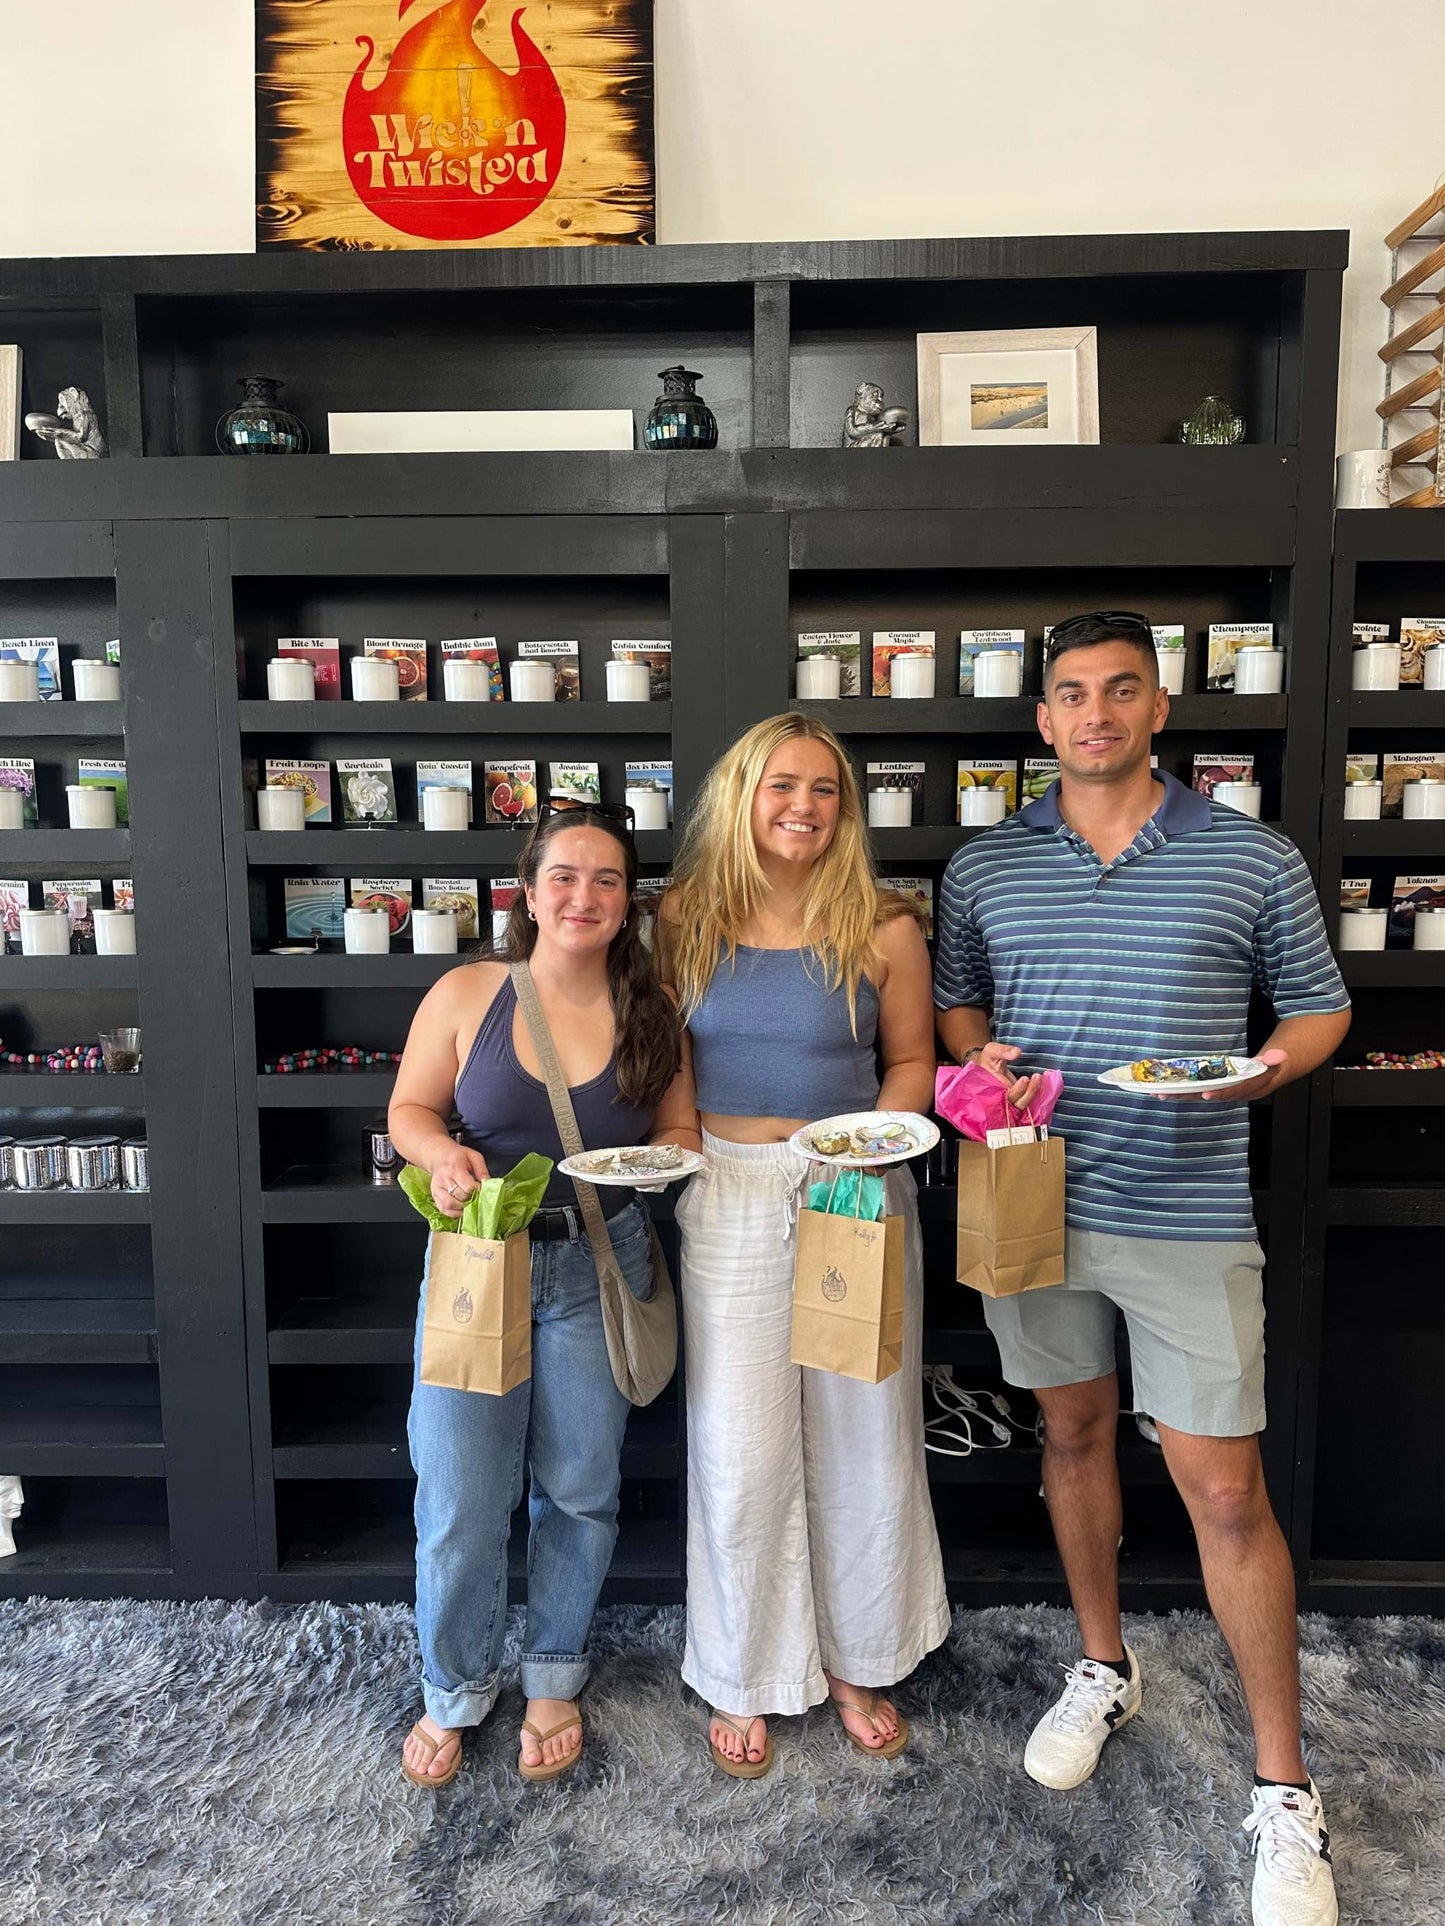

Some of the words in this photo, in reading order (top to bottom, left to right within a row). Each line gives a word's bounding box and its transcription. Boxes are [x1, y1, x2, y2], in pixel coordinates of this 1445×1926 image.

[353, 148, 548, 195] Twisted
[1212, 625, 1270, 634] Champagne
[1, 641, 27, 649] Beach
[29, 639, 55, 647] Linen
[290, 639, 309, 648] Bite
[311, 639, 324, 648] Me
[366, 639, 389, 648] Blood
[391, 640, 424, 650] Orange
[443, 641, 472, 650] Bubble
[473, 640, 494, 648] Gum
[613, 642, 637, 650] Cabin
[638, 641, 672, 650] Comfort
[1195, 755, 1219, 764] Lychee
[1393, 755, 1436, 763] Mahogany
[10, 760, 31, 768] Lilac
[269, 760, 296, 768] Fruit
[297, 760, 326, 769] Loops
[344, 761, 384, 769] Gardenia
[440, 762, 469, 770] Coastal
[489, 763, 531, 773] Grapefruit
[558, 763, 589, 771] Jasmine
[879, 763, 914, 771] Leather
[972, 760, 1003, 768] Lemon
[362, 879, 400, 887] Raspberry
[495, 879, 515, 887] Rose
[1406, 877, 1438, 885] Volcano
